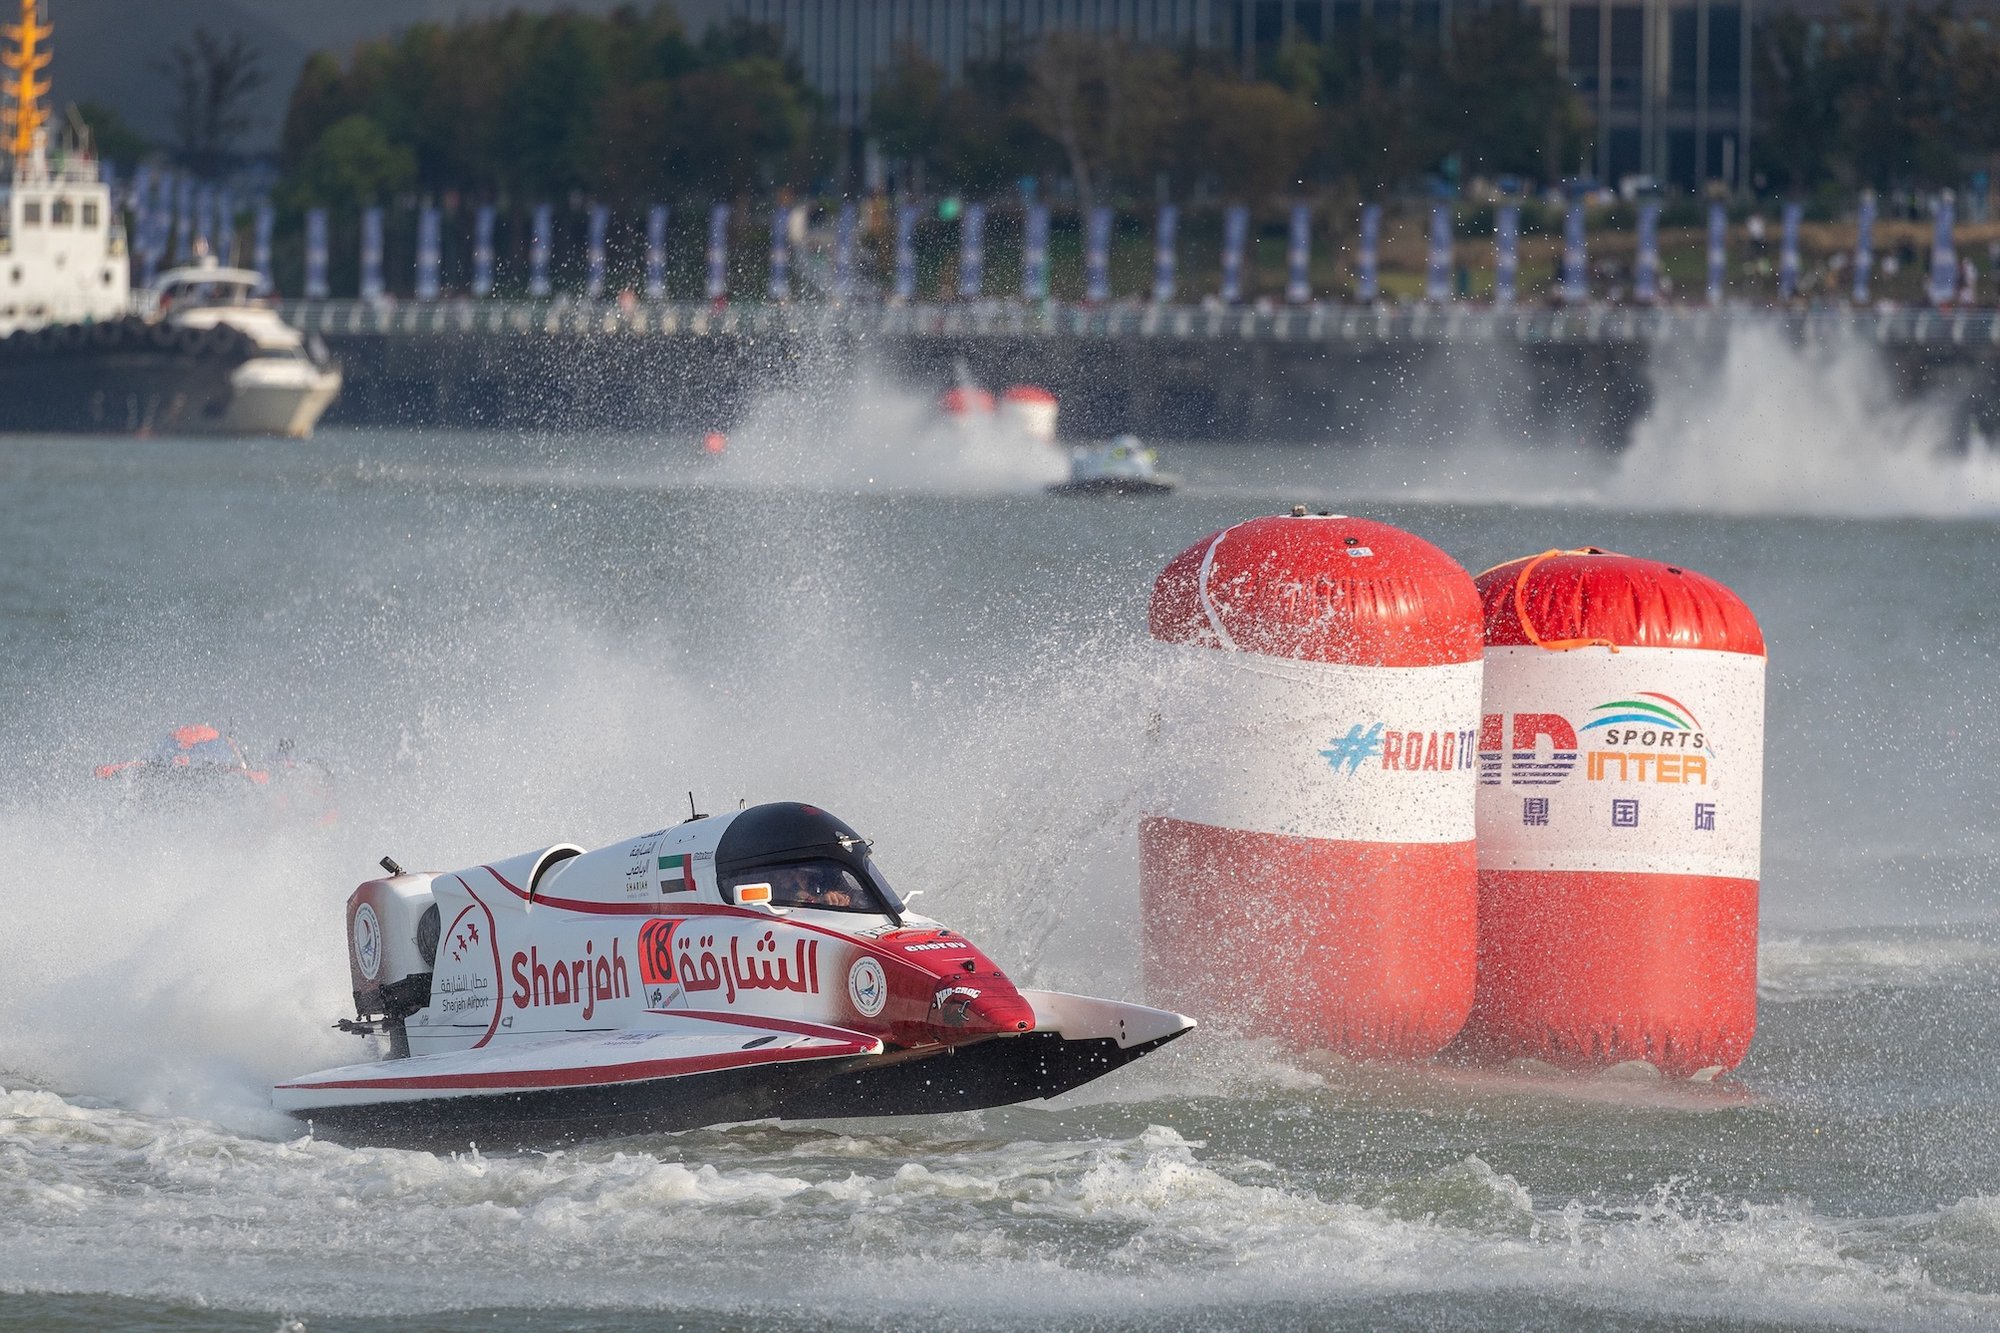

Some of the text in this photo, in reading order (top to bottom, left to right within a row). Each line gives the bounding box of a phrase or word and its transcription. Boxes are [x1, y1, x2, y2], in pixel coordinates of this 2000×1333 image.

[1605, 729, 1705, 749] SPORTS
[641, 922, 675, 981] 18
[678, 930, 820, 1004] الشارقة
[440, 974, 468, 995] الشارقة
[511, 937, 630, 1021] Sharjah
[442, 995, 489, 1013] Sharjah Airport
